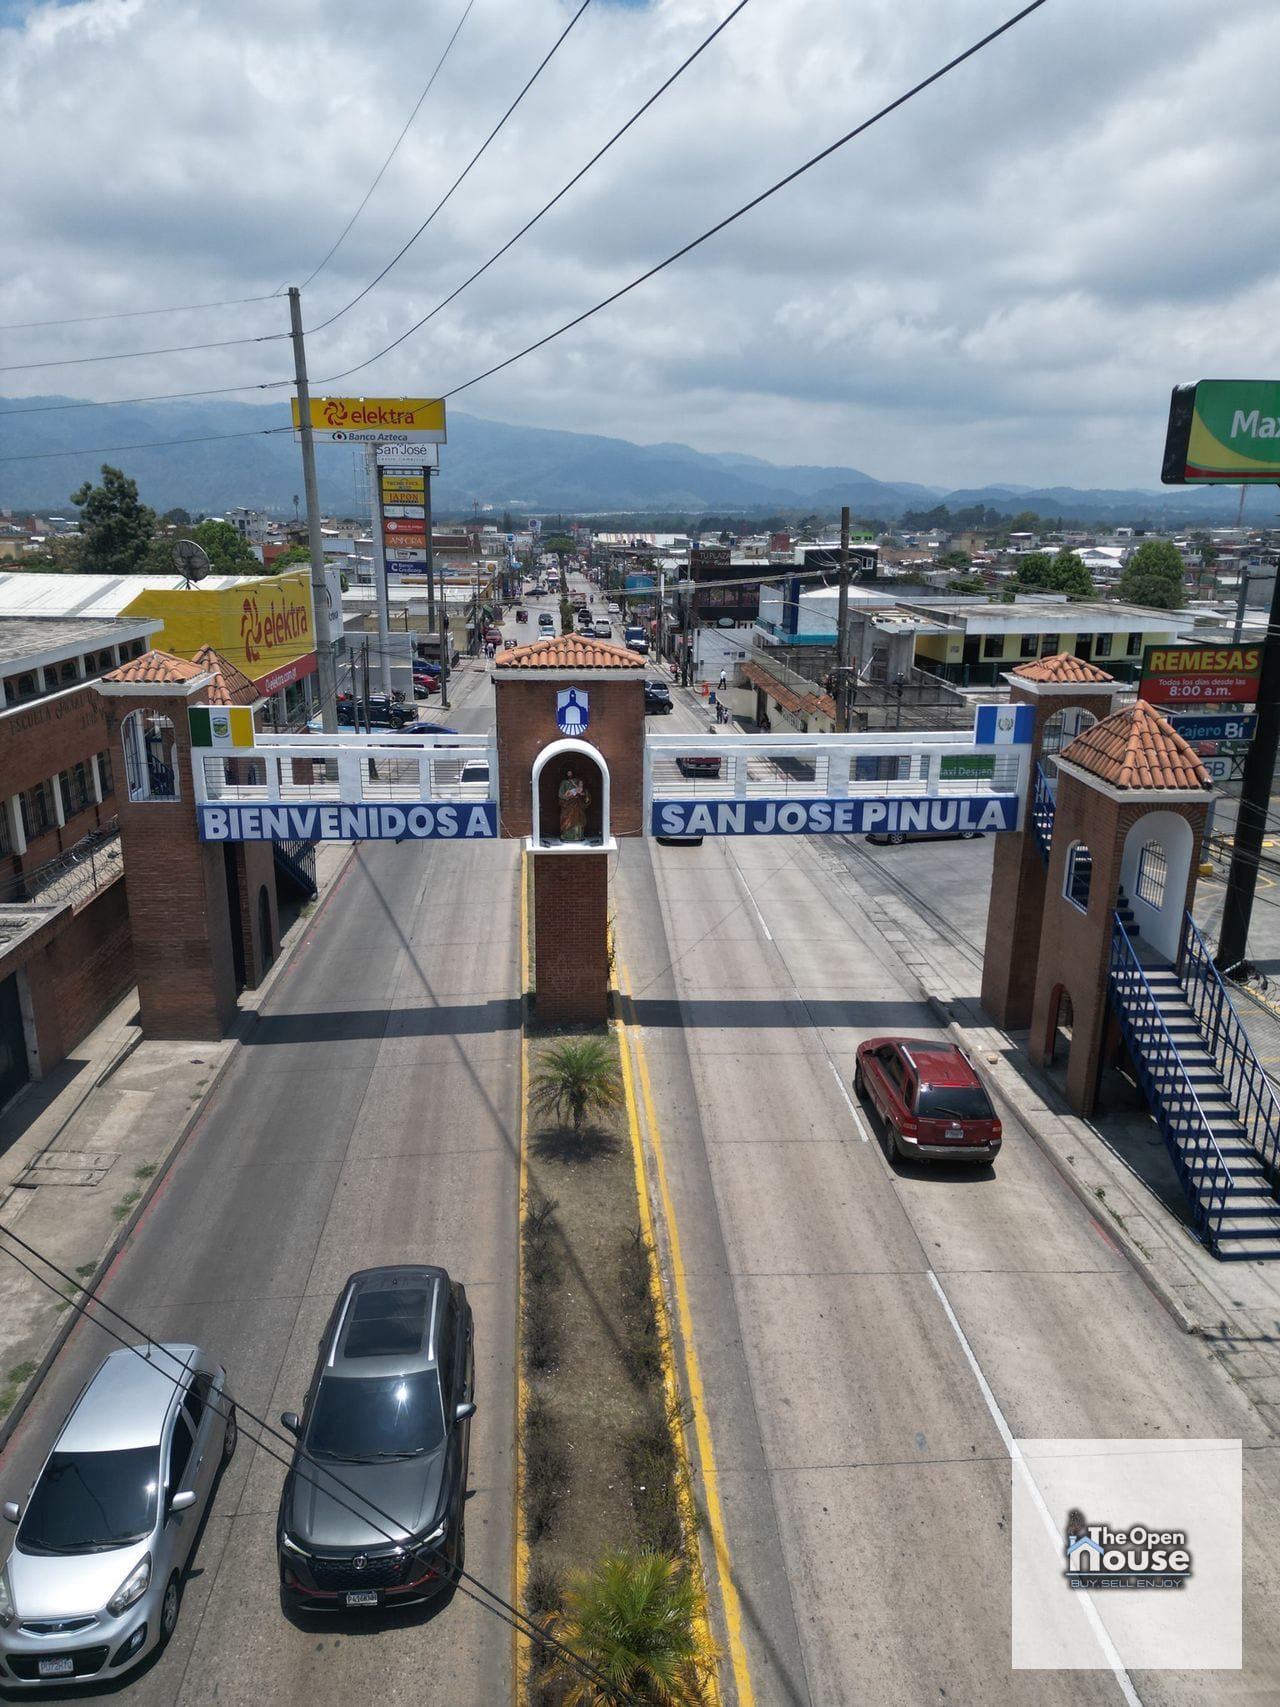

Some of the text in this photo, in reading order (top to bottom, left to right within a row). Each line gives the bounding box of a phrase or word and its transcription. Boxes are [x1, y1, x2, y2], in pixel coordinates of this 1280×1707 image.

[351, 406, 414, 424] elektra
[348, 432, 408, 441] Banco Azteca
[376, 444, 399, 455] San
[263, 596, 308, 649] elektra
[1149, 651, 1259, 671] REMESAS
[1169, 686, 1231, 696] 8:00 a.m.
[1183, 678, 1193, 686] los
[1211, 678, 1234, 686] desde
[1177, 719, 1247, 739] Cajero Bi
[203, 806, 493, 839] BIENVENIDOS A
[661, 801, 1006, 834] SAN JOSE PINULA
